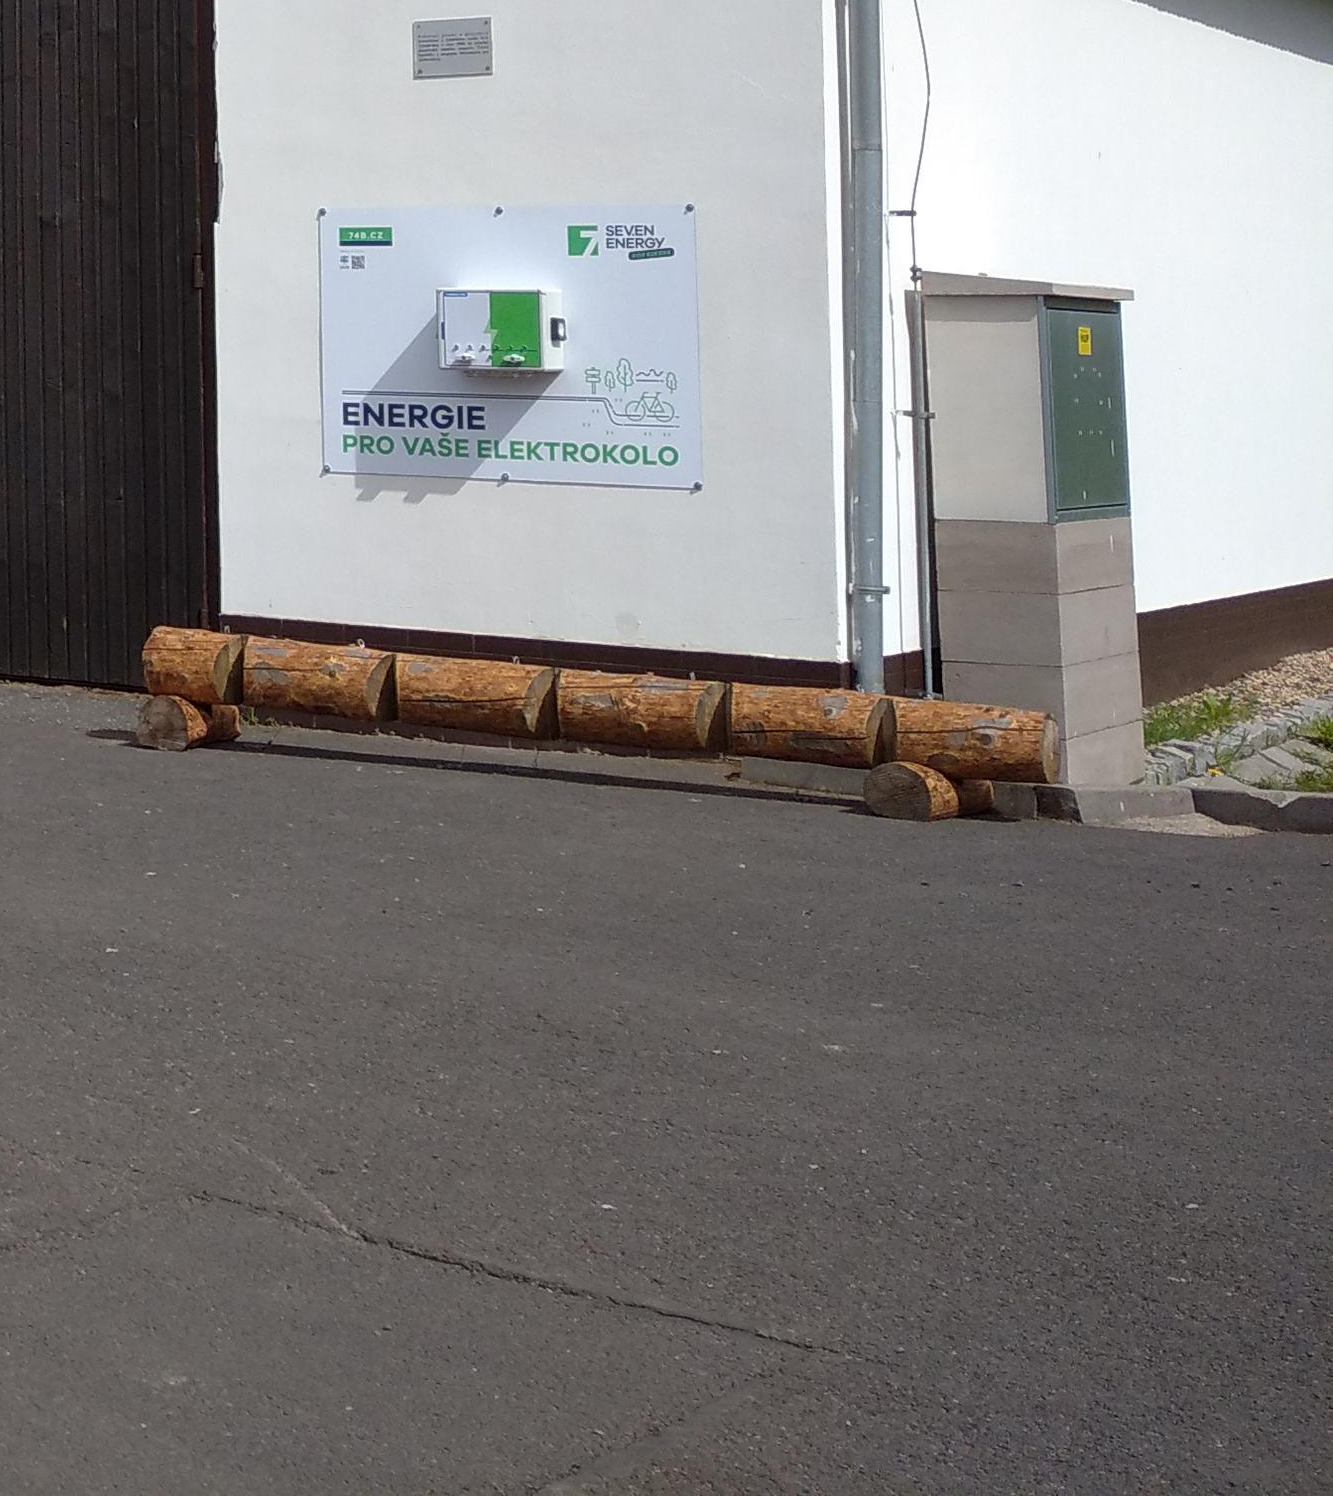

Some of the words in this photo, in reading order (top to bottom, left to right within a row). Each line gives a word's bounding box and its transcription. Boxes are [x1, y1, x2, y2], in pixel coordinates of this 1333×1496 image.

[605, 224, 654, 237] SEVEN
[605, 237, 665, 249] ENERGY
[341, 401, 487, 432] ENERGIE
[341, 434, 395, 456] PRO
[401, 433, 471, 459] VAŠE
[476, 439, 680, 467] ELEKTROKOLO
